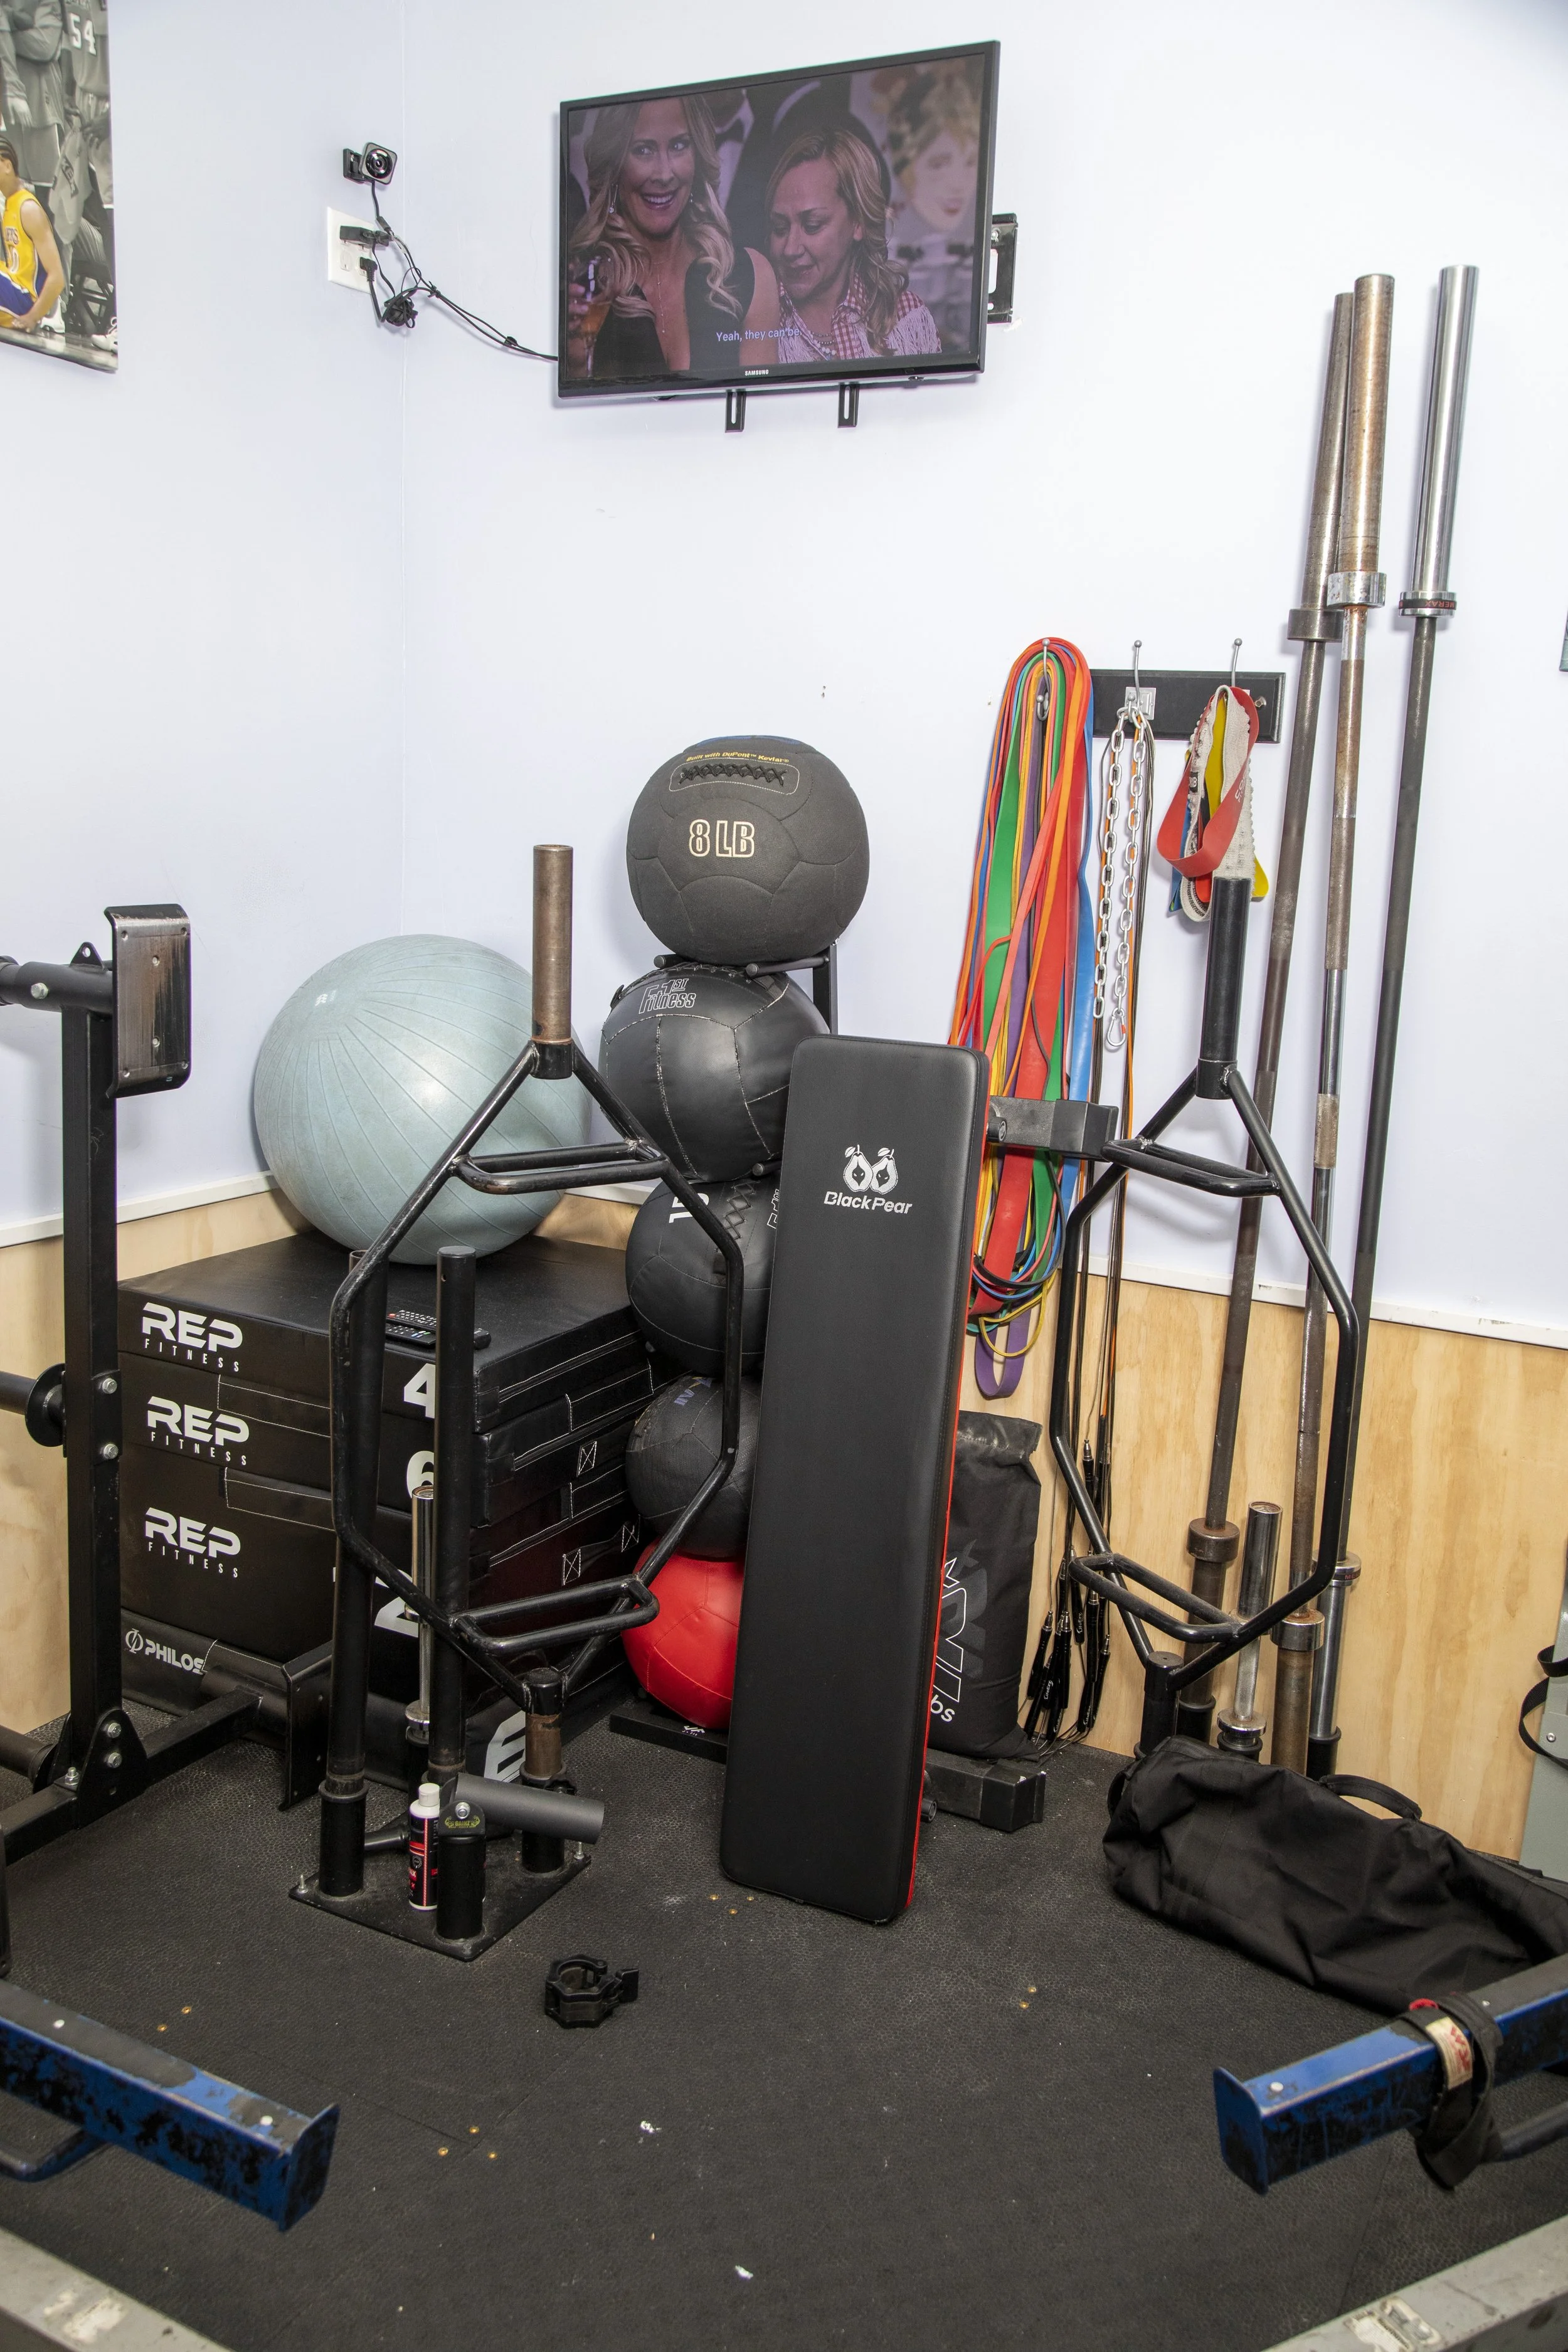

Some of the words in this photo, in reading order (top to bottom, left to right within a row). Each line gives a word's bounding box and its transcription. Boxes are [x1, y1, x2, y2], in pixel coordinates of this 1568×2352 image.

[68, 12, 97, 56] 54
[716, 331, 742, 342] Yeah,
[745, 329, 766, 341] they
[768, 329, 785, 337] can
[689, 819, 710, 857] 8
[716, 820, 755, 857] LB
[638, 984, 696, 1014] Fitness
[142, 1302, 243, 1352] REP
[145, 1338, 239, 1372] FITNESS
[147, 1396, 250, 1446] REP
[151, 1431, 246, 1465] FITNESS
[146, 1507, 241, 1558] REP
[149, 1542, 238, 1577] FITNESS
[145, 1638, 204, 1675] PHILOS
